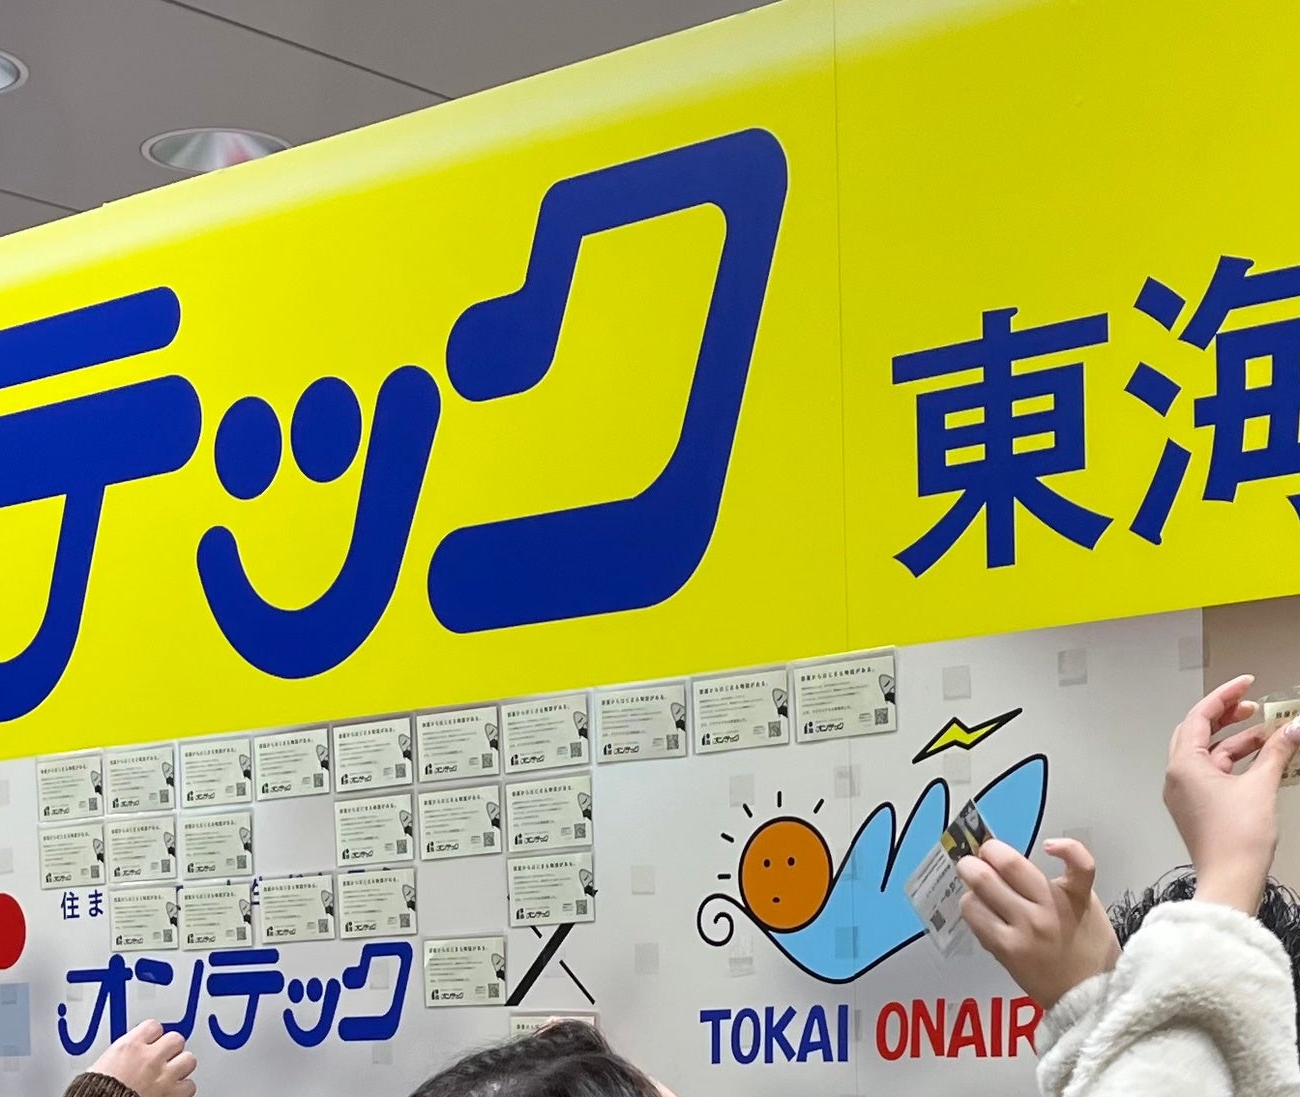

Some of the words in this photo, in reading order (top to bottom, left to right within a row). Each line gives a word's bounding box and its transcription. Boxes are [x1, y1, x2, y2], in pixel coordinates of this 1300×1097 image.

[57, 941, 414, 1056] オンテック
[699, 1004, 849, 1065] TOKAI
[876, 996, 1044, 1061] ONAIR
